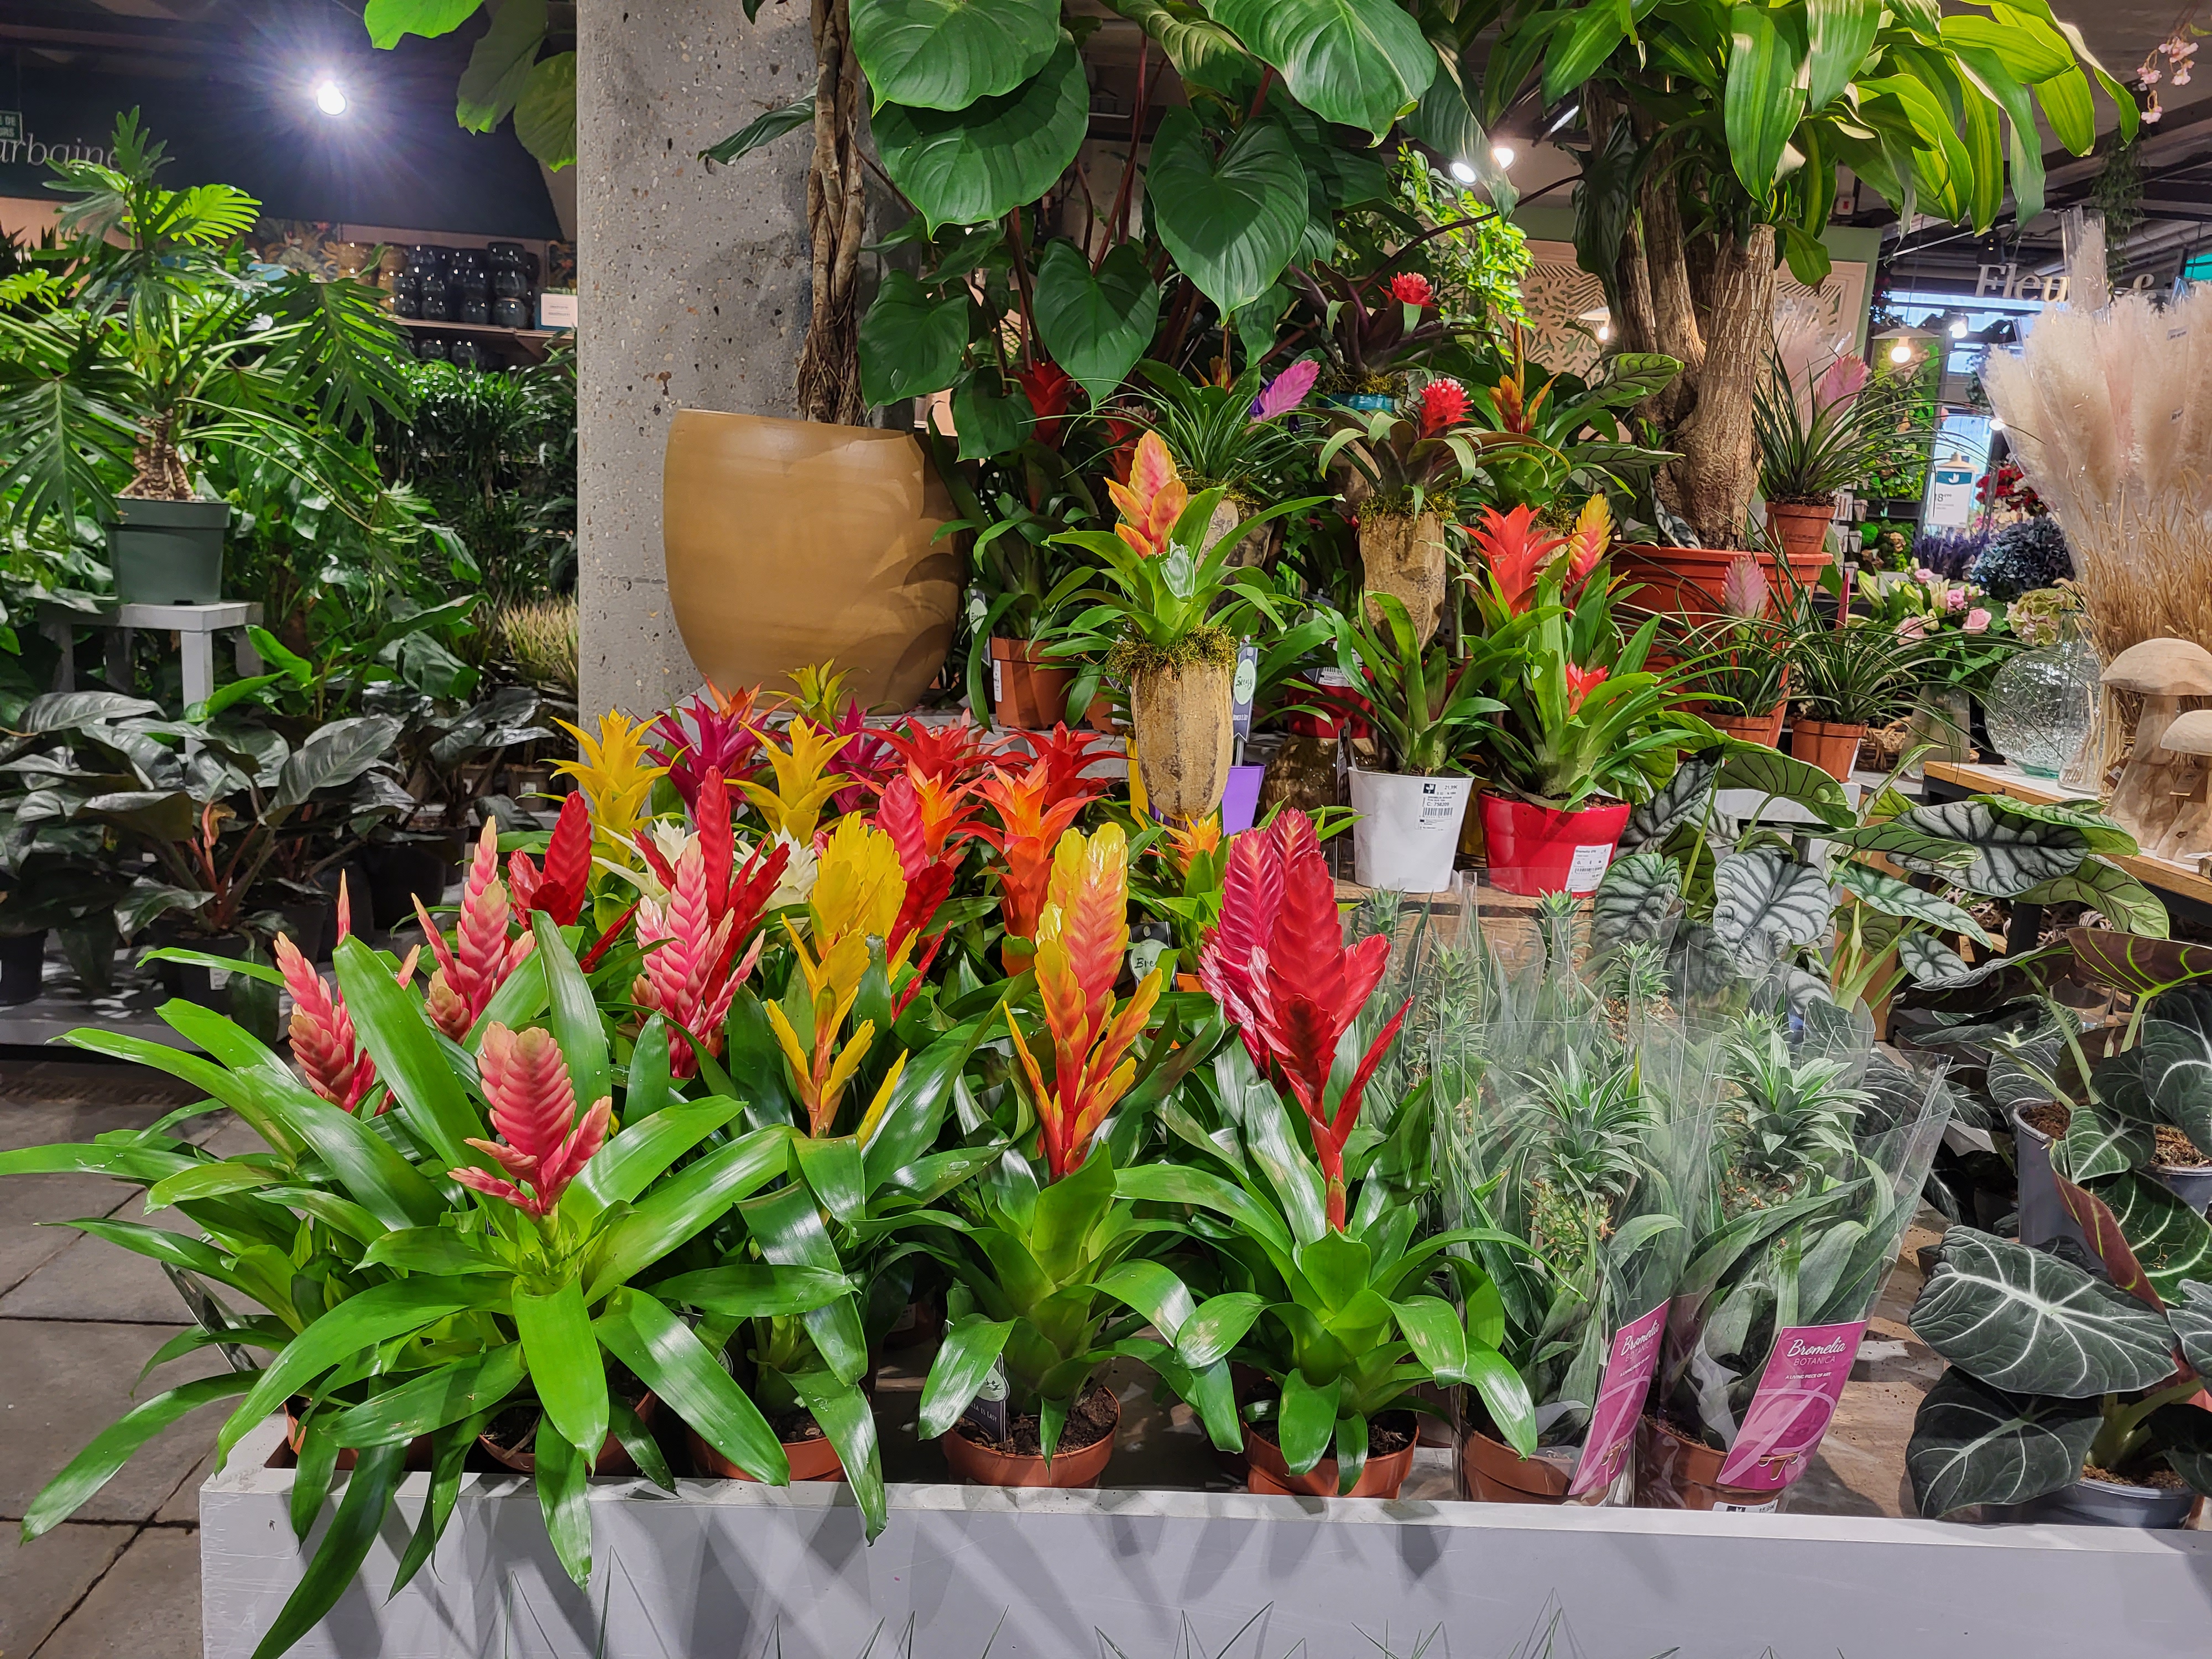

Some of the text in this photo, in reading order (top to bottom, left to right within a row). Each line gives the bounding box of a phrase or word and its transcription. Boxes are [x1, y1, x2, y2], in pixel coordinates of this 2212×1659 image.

[1620, 1319, 1660, 1356] Bromelia
[1787, 1335, 1846, 1357] Bromelia
[1793, 1355, 1836, 1366] BOTANICA
[987, 1411, 997, 1422] EASY
